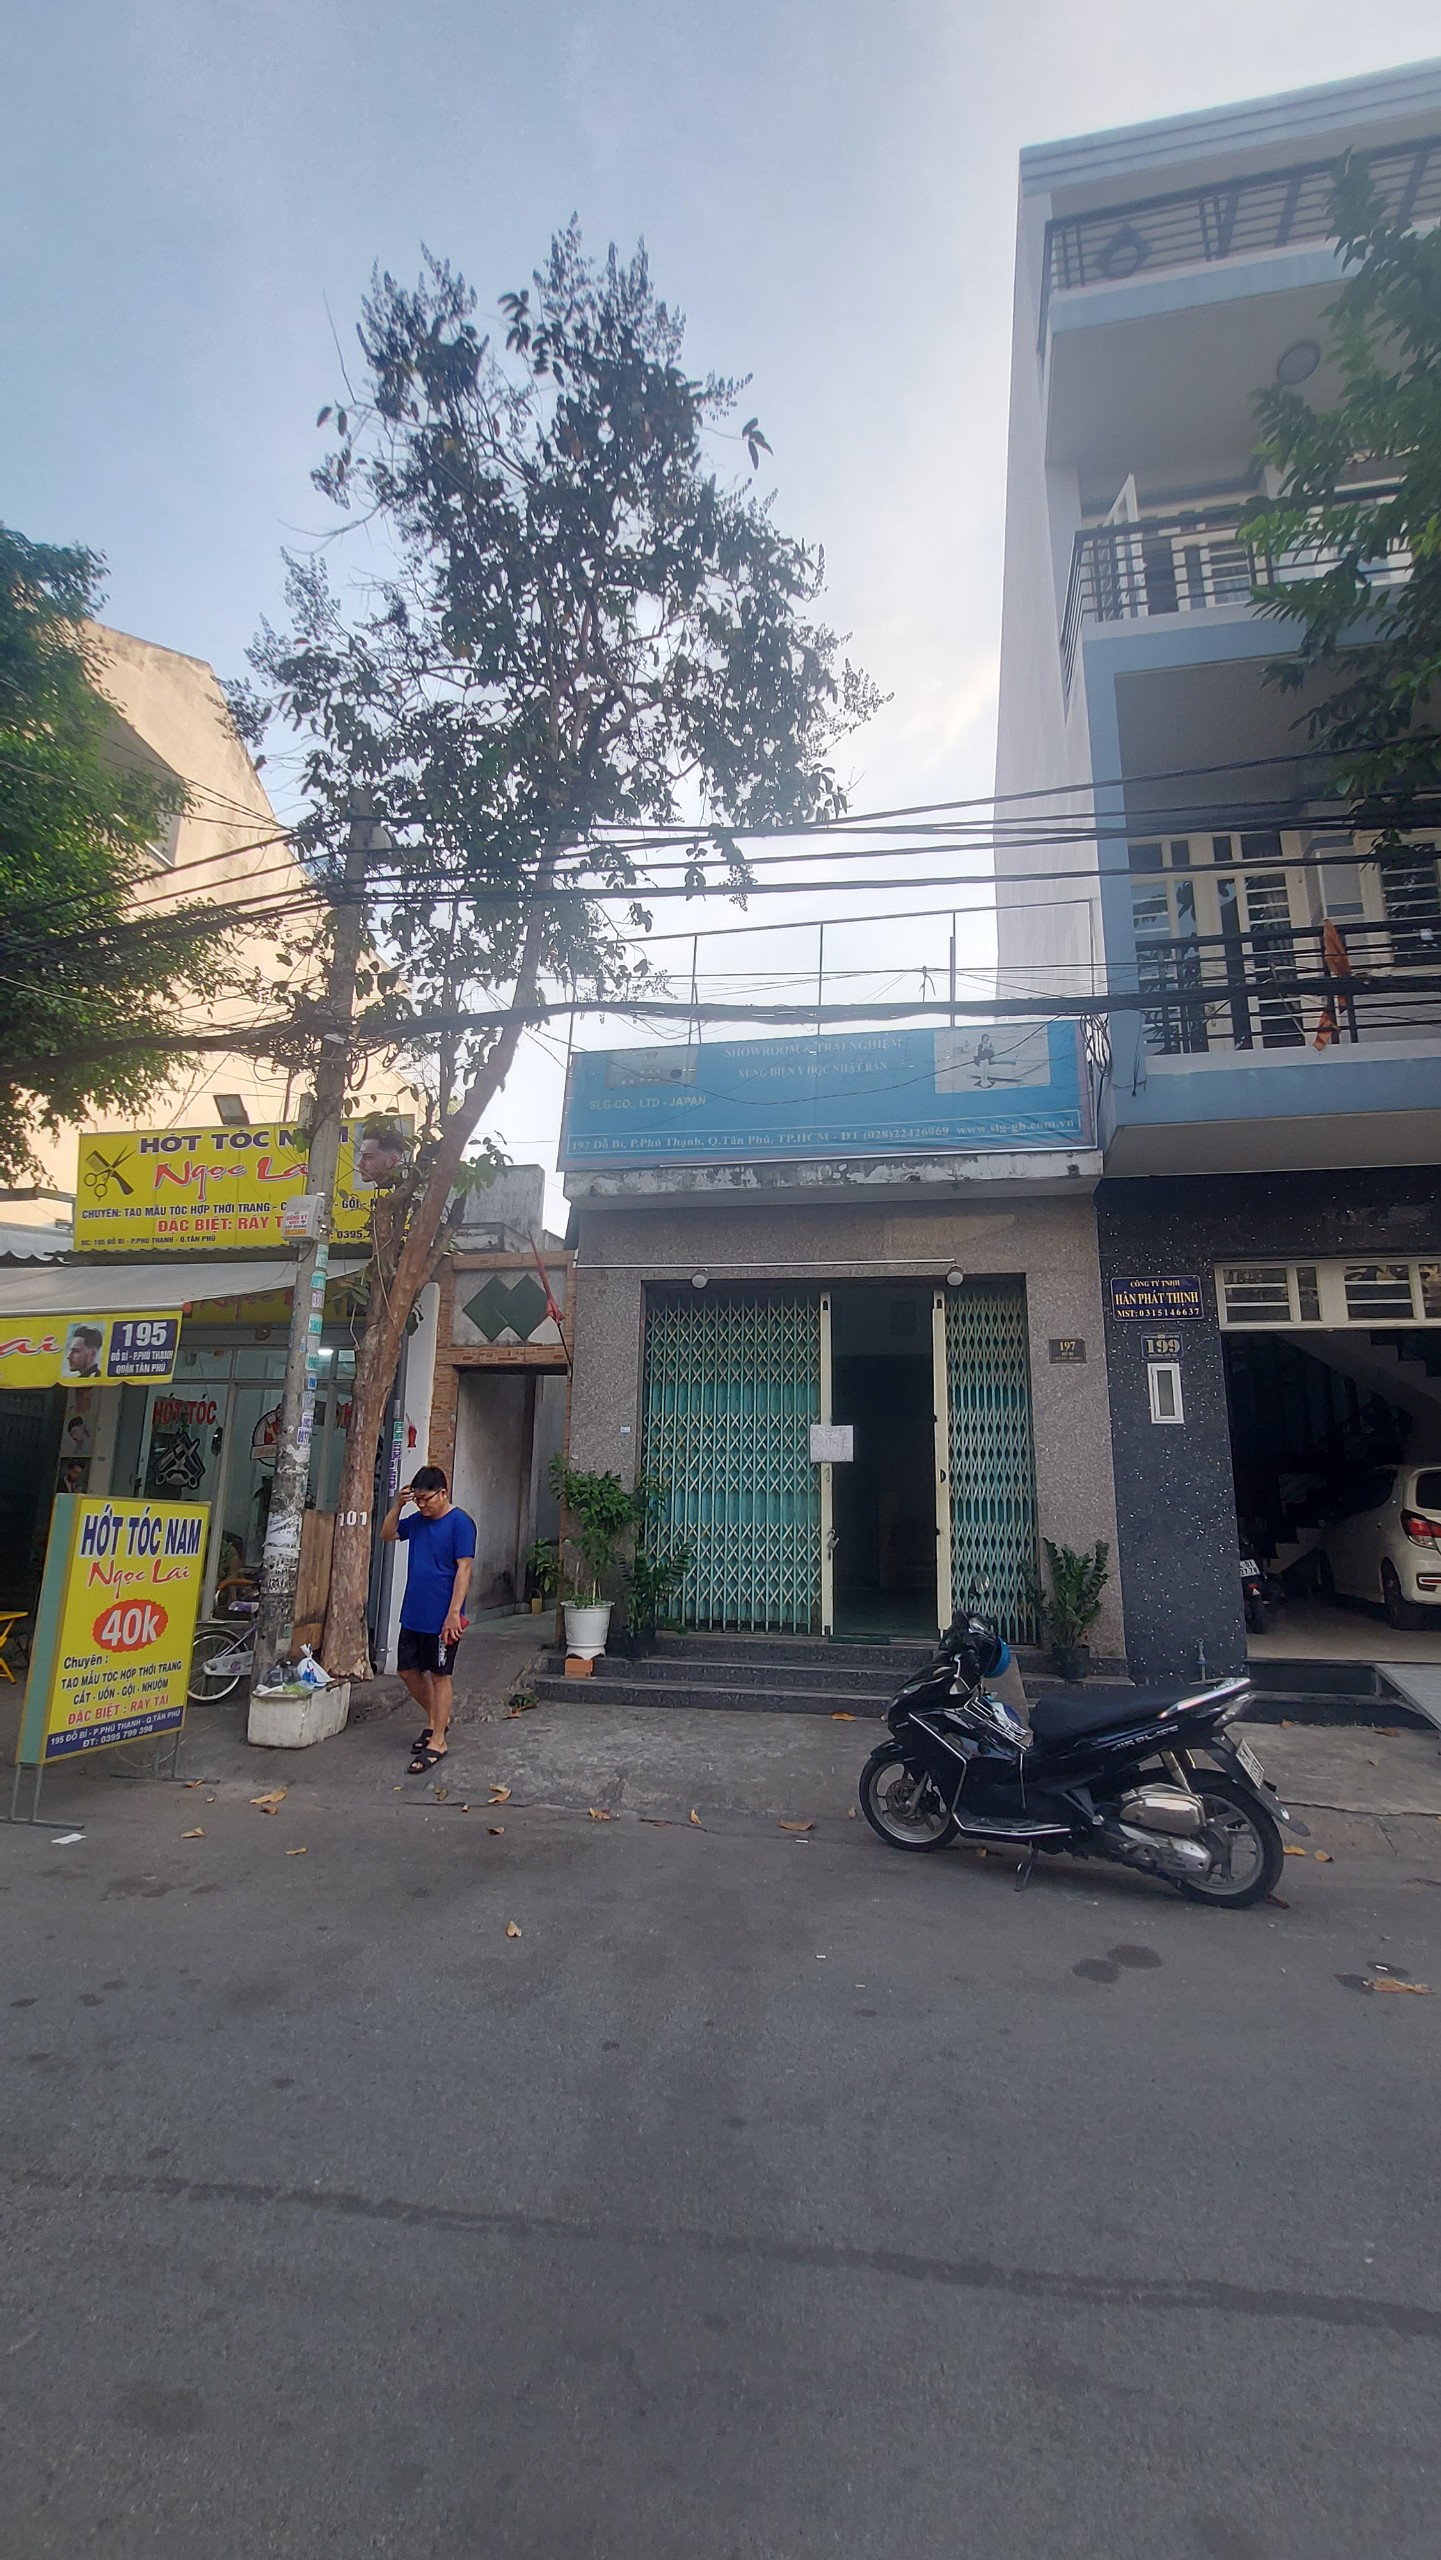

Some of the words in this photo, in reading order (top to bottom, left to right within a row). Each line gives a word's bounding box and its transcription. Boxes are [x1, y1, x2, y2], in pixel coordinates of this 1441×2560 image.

[725, 1045, 799, 1058] SHOWROOM
[589, 1100, 612, 1110] SLG
[639, 1098, 660, 1108] LTD
[669, 1096, 707, 1108] JAPAN
[210, 1130, 270, 1150] TÓC
[573, 1141, 590, 1150] 197
[778, 1132, 829, 1144] TP.HCM
[841, 1131, 858, 1141] ĐT
[154, 1160, 246, 1201] Ngọc
[82, 1206, 122, 1219] CHUYÊN:
[125, 1208, 142, 1219] TẠO
[169, 1204, 187, 1216] TÓC
[190, 1204, 210, 1217] HỢP
[213, 1202, 235, 1214] THỜI
[238, 1202, 270, 1213] TRANG
[158, 1217, 190, 1234] ĐẶC
[195, 1215, 232, 1233] BIỆT:
[1130, 1279, 1150, 1288] CÔNG
[1138, 1289, 1165, 1305] PHÁT
[1166, 1291, 1199, 1307] THỊNH
[1117, 1309, 1138, 1318] MST:
[122, 1322, 168, 1347] 195
[1059, 1341, 1076, 1351] 197
[1147, 1339, 1181, 1353] 199
[135, 1361, 150, 1373] TÂN
[151, 1361, 166, 1373] PHÚ
[187, 1394, 218, 1425] TÓC
[339, 1510, 368, 1527] 101
[80, 1504, 124, 1556] HỚT
[127, 1506, 162, 1556] TÓC
[164, 1518, 203, 1555] NAM
[87, 1559, 145, 1600] Ngọc
[152, 1558, 190, 1584] Lai
[101, 1605, 160, 1647] 40k
[61, 1677, 79, 1692] TẠO
[81, 1670, 100, 1687] MẪU
[120, 1668, 137, 1681] HỢP
[139, 1662, 156, 1676] THỜI
[158, 1660, 182, 1673] TRANG
[141, 1678, 169, 1693] NHUỘM
[67, 1709, 92, 1726] ĐẶC
[95, 1703, 120, 1720] BIỆT
[154, 1694, 169, 1707] TAI
[51, 1735, 65, 1746] 195
[167, 1708, 181, 1719] PHÚ
[82, 1738, 99, 1748] ĐT:
[100, 1732, 121, 1744] 0395
